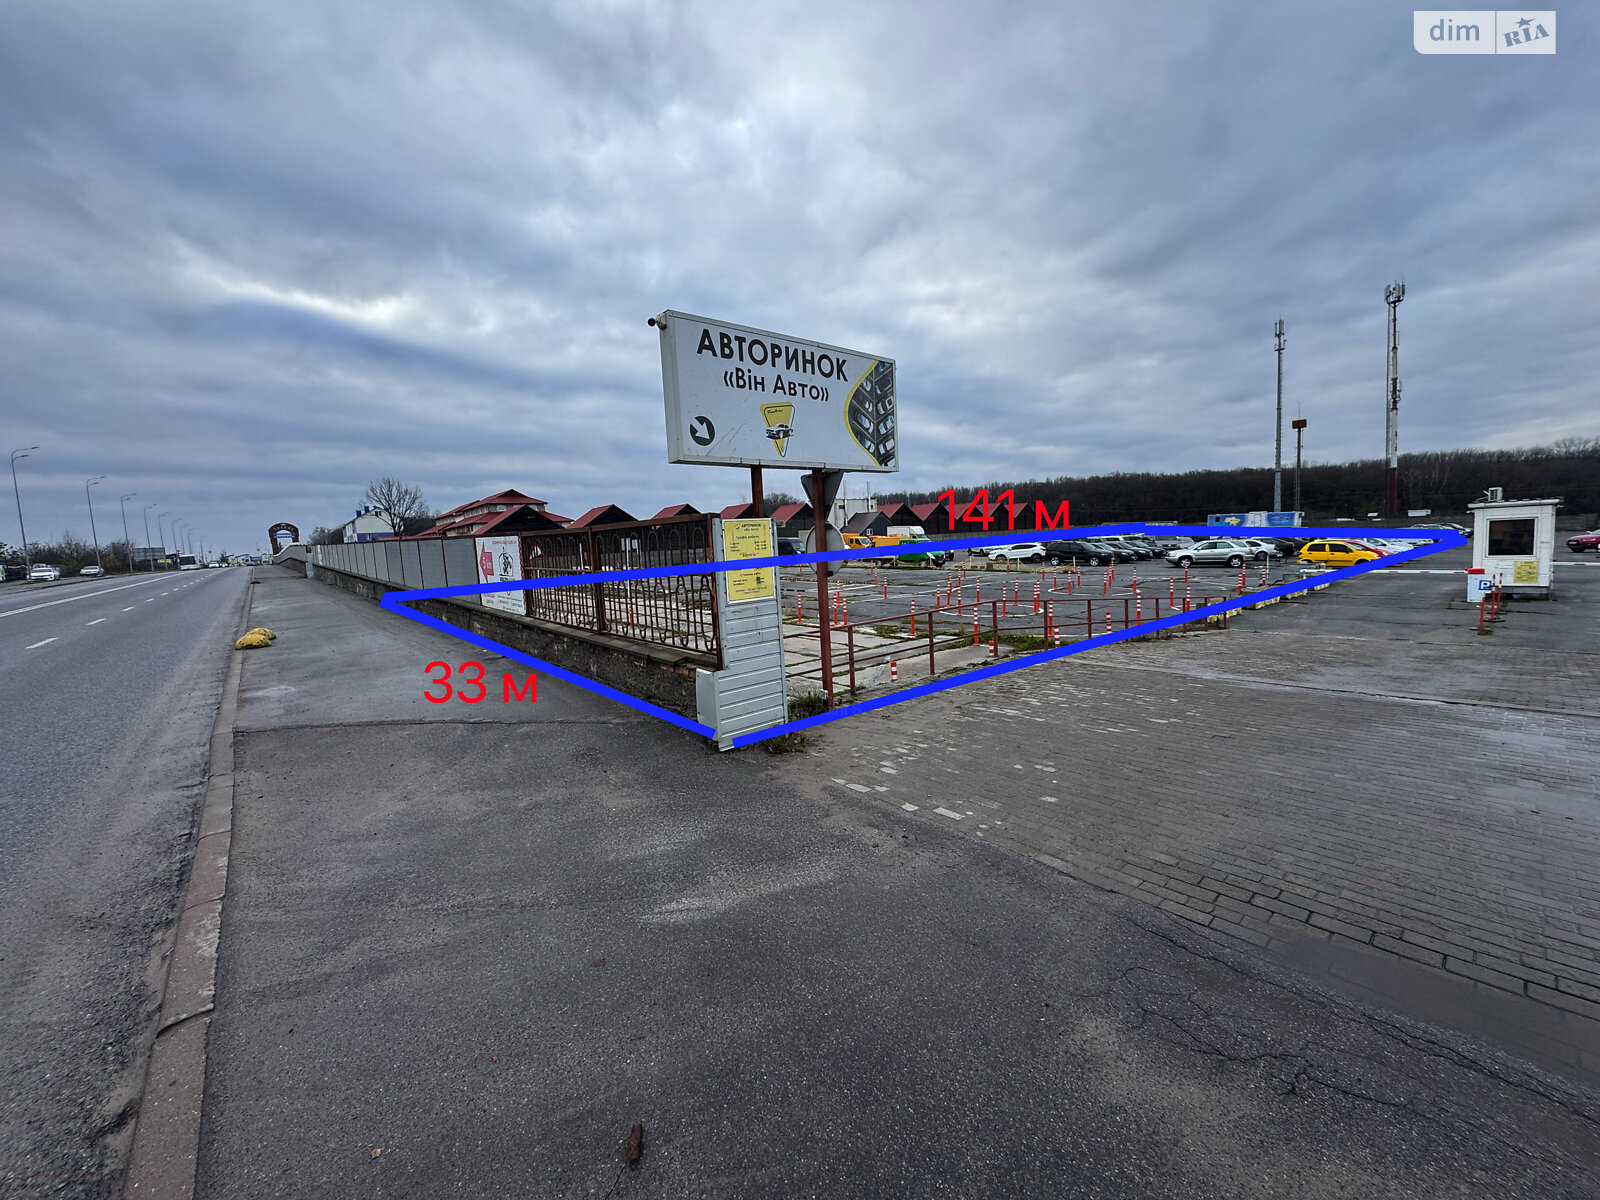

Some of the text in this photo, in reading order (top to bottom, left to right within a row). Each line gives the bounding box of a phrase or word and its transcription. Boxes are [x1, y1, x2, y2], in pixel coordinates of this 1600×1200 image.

[696, 328, 849, 382] АВТОРИНОК
[723, 366, 829, 402] «Він Авто»
